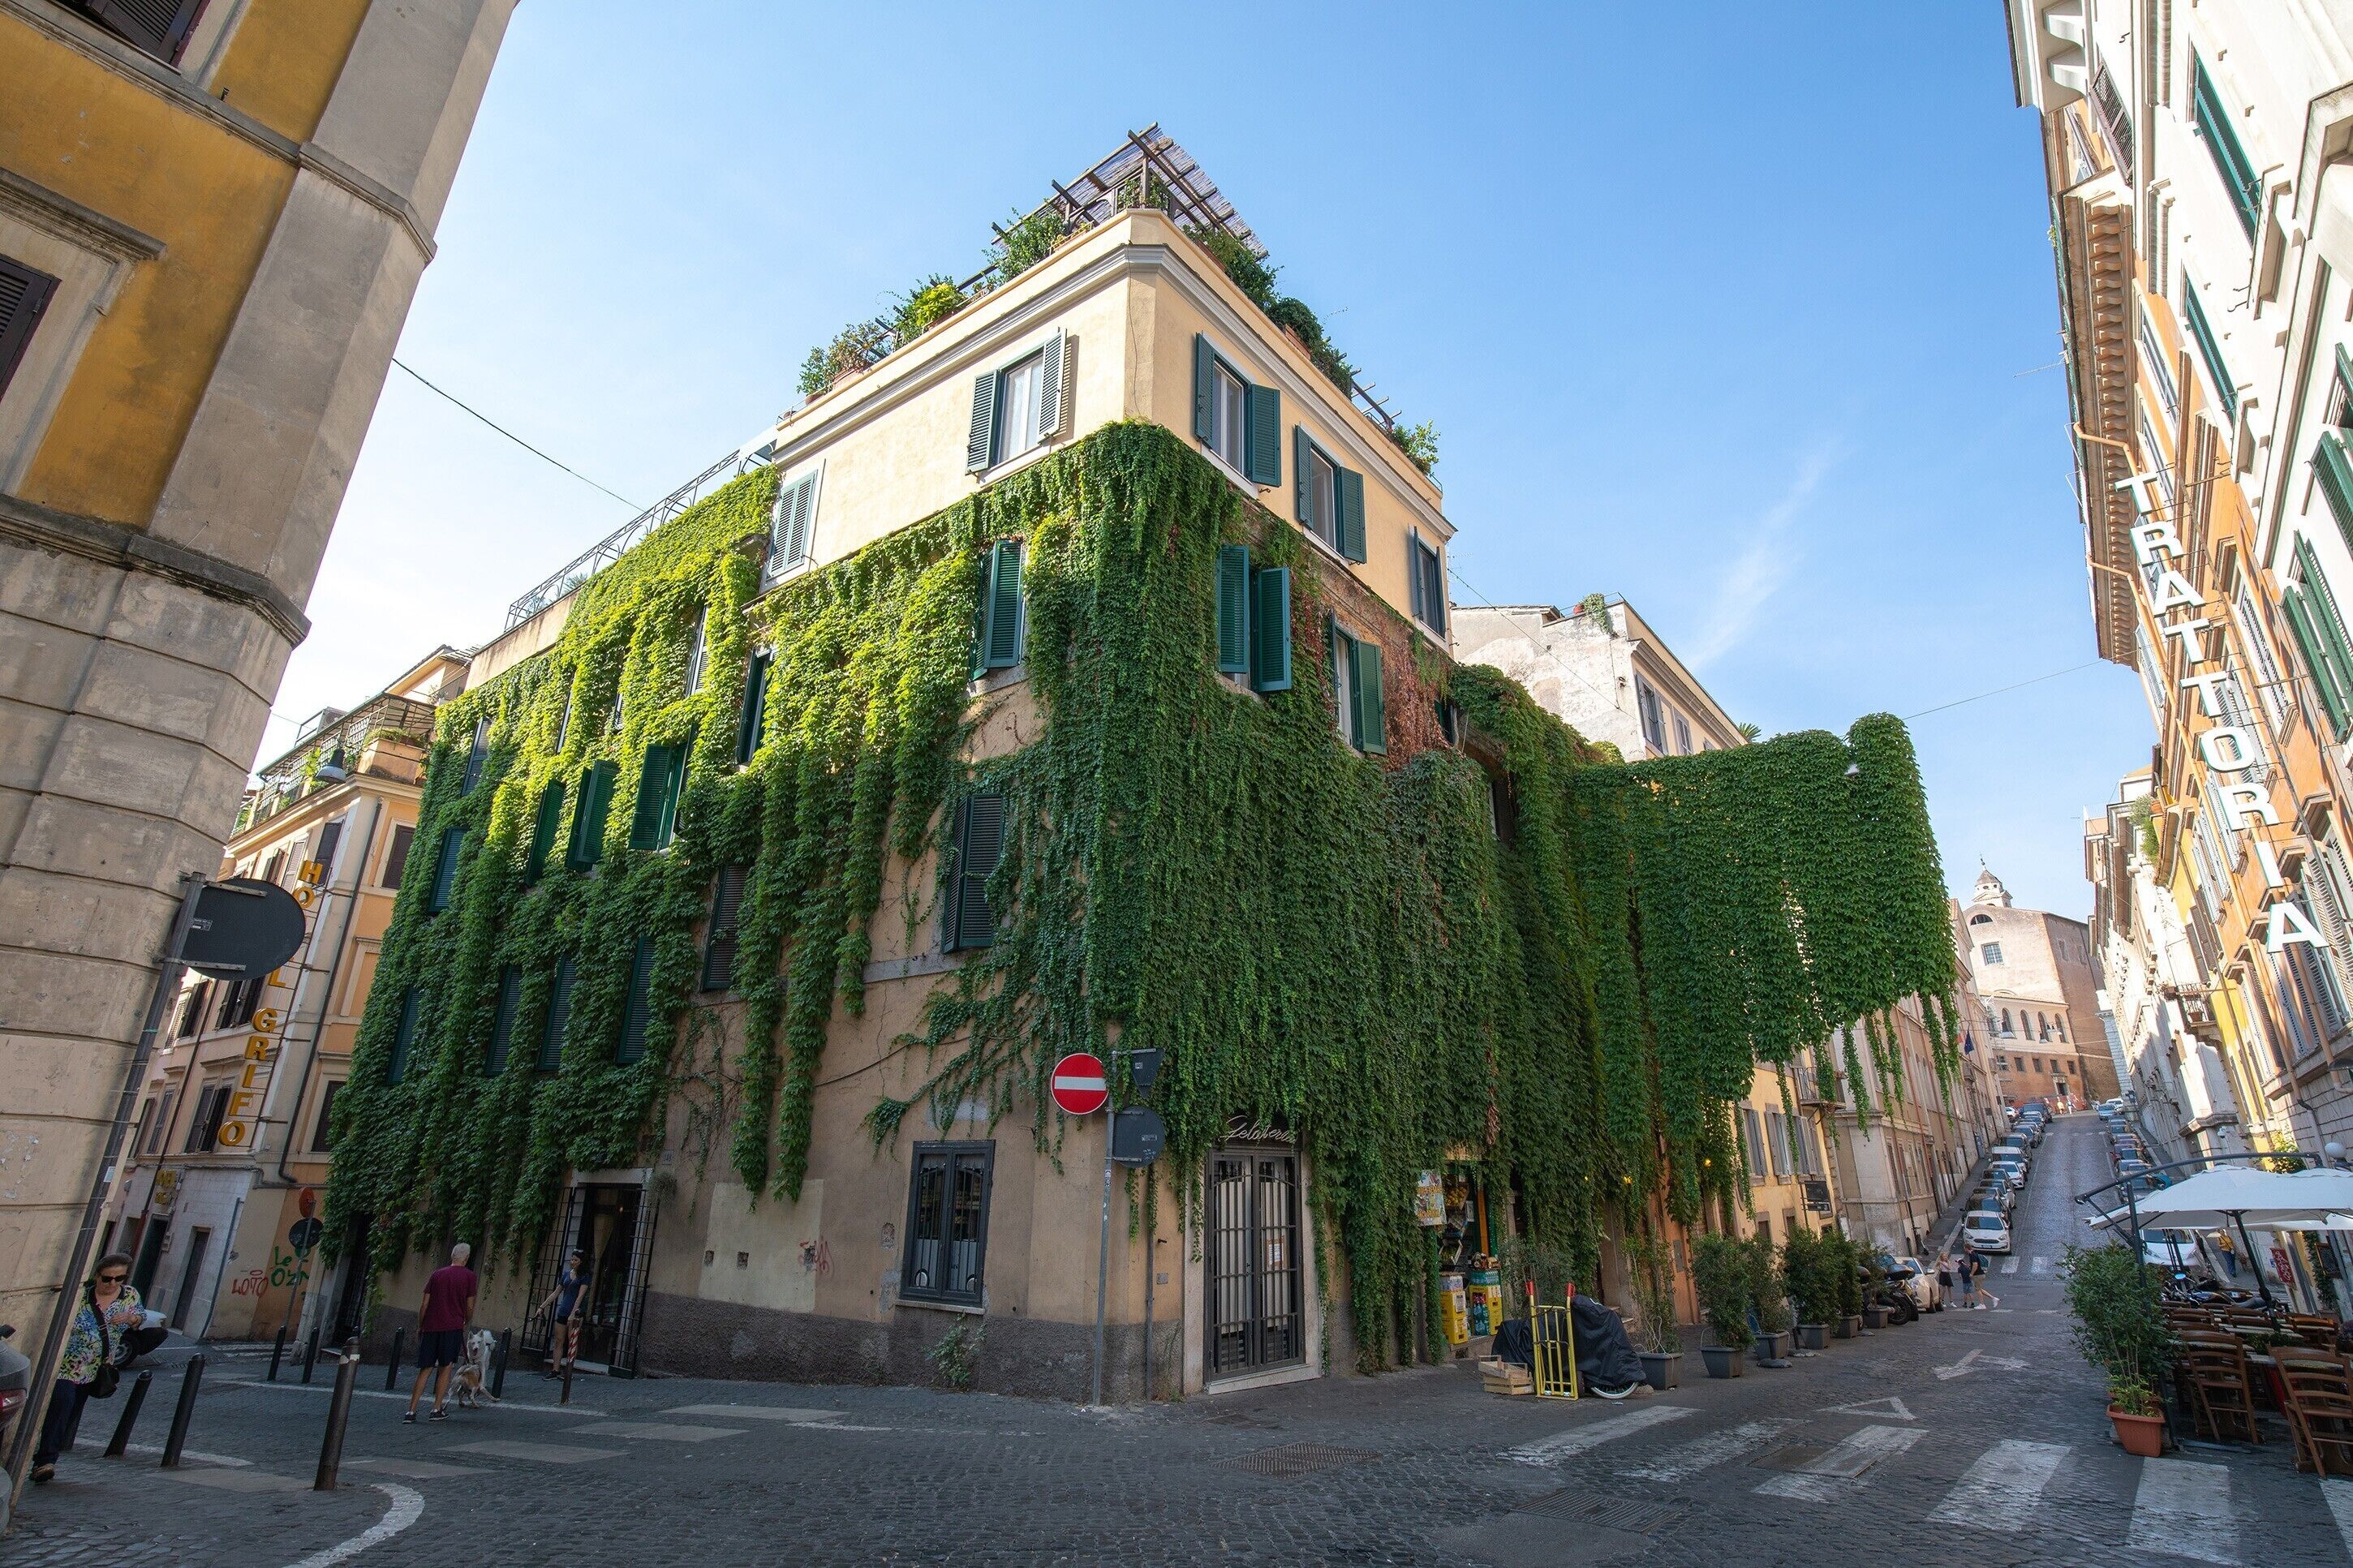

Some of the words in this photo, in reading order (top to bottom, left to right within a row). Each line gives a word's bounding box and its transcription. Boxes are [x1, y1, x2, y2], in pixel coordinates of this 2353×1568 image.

[2114, 473, 2329, 953] TRATTORIA
[268, 859, 323, 987] HOL
[217, 1007, 278, 1147] GRIFO
